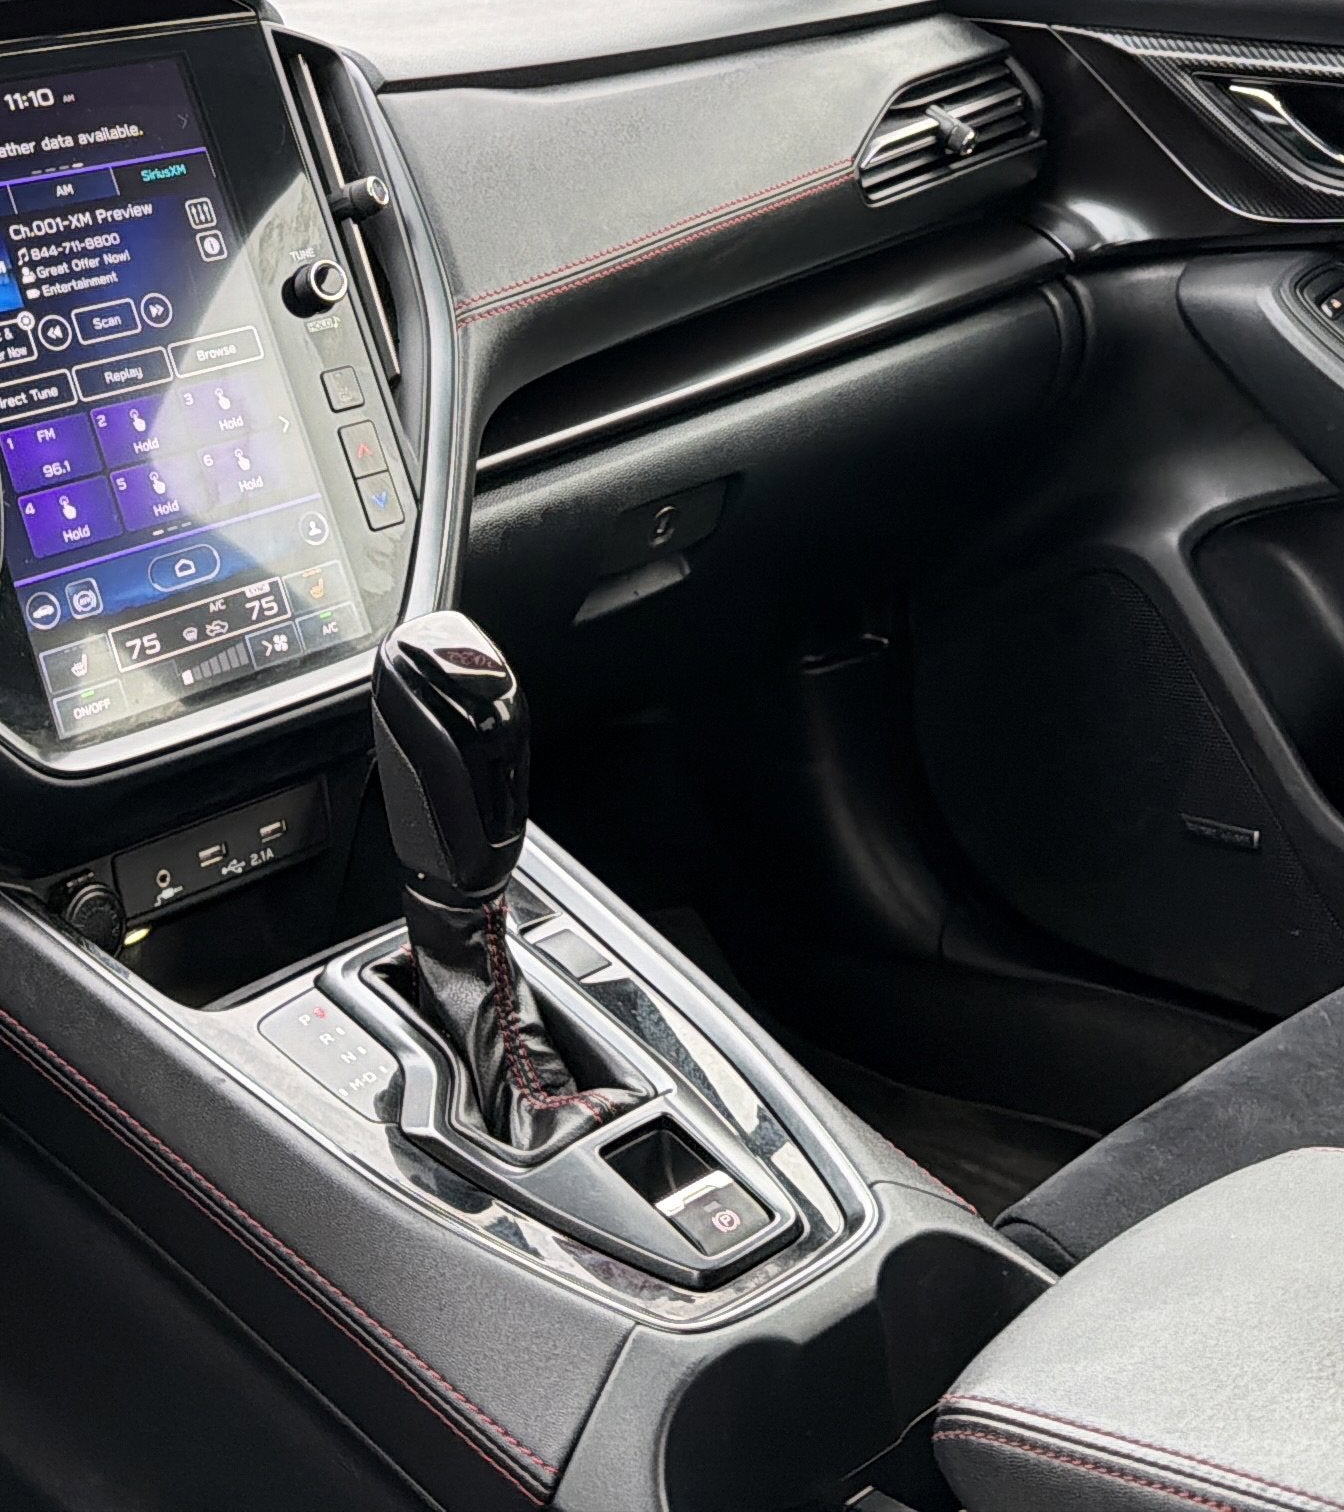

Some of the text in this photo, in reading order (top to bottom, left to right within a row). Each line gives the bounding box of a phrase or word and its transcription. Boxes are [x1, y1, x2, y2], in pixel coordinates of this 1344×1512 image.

[4, 88, 55, 111] 11:10
[62, 94, 75, 103] AM
[41, 134, 75, 150] data
[78, 123, 145, 146] available.
[141, 164, 187, 182] SiriusXM
[56, 184, 75, 198] AM
[9, 201, 153, 241] Ch.001-XM Preview
[31, 232, 121, 260] 844-711-8800
[289, 247, 316, 262] TUNE
[36, 261, 69, 279] Great
[72, 256, 100, 273] Offer
[42, 271, 119, 297] Entertainment
[92, 314, 122, 330] Scan
[3, 327, 15, 341] &
[196, 343, 237, 362] Browse
[104, 366, 144, 385] Replay
[30, 384, 59, 402] Tune
[183, 393, 194, 406] 3
[96, 414, 107, 428] 2
[218, 415, 245, 431] Hold
[6, 438, 15, 450] 1
[36, 428, 56, 443] FM
[132, 438, 160, 455] Hold
[202, 454, 214, 467] 6
[116, 477, 127, 491] 5
[238, 476, 264, 493] Hold
[24, 502, 36, 516] 4
[153, 499, 180, 517] Hold
[63, 524, 91, 543] Hold
[245, 596, 279, 621] 75
[125, 633, 162, 660] 75
[73, 698, 111, 720] ON/OFF
[250, 848, 275, 867] 2.1A
[319, 1033, 335, 1045] R
[340, 1051, 357, 1064] N
